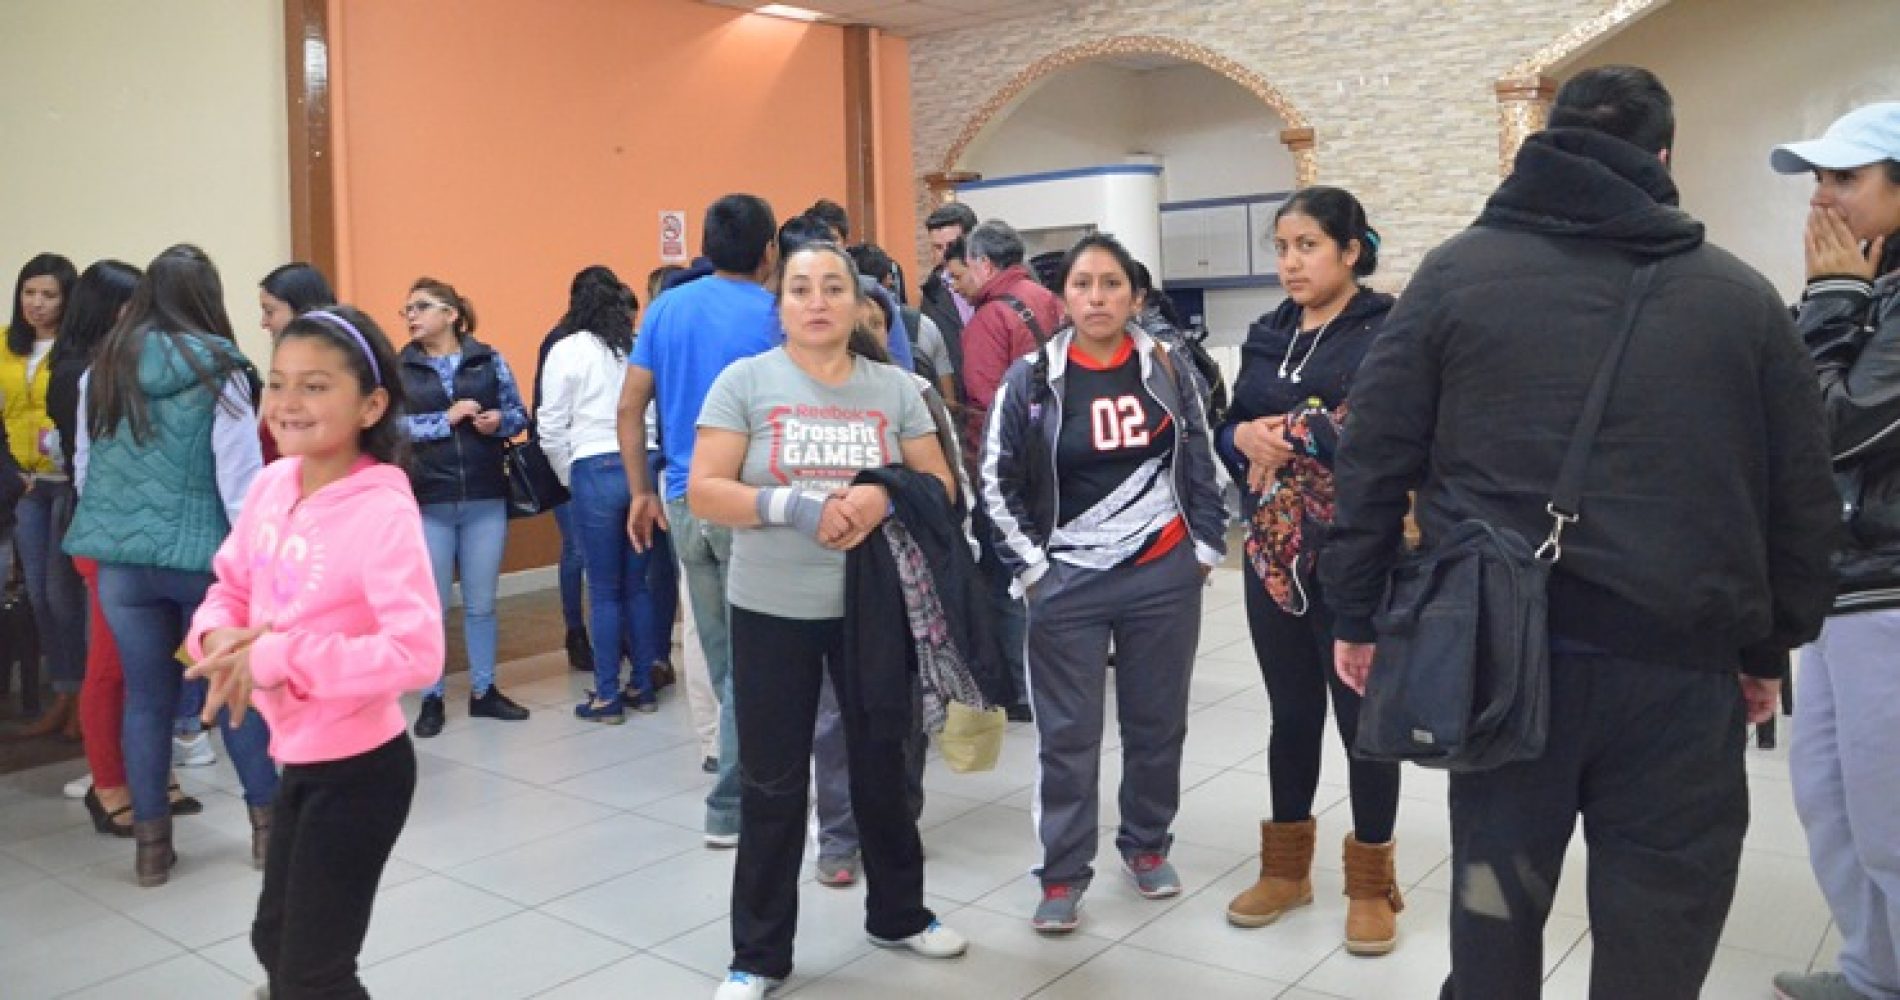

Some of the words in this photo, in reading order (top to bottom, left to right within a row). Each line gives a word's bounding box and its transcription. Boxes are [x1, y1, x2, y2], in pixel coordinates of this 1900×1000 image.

[786, 419, 878, 443] CrossFit
[1091, 395, 1150, 451] 02
[783, 442, 881, 468] GAMES
